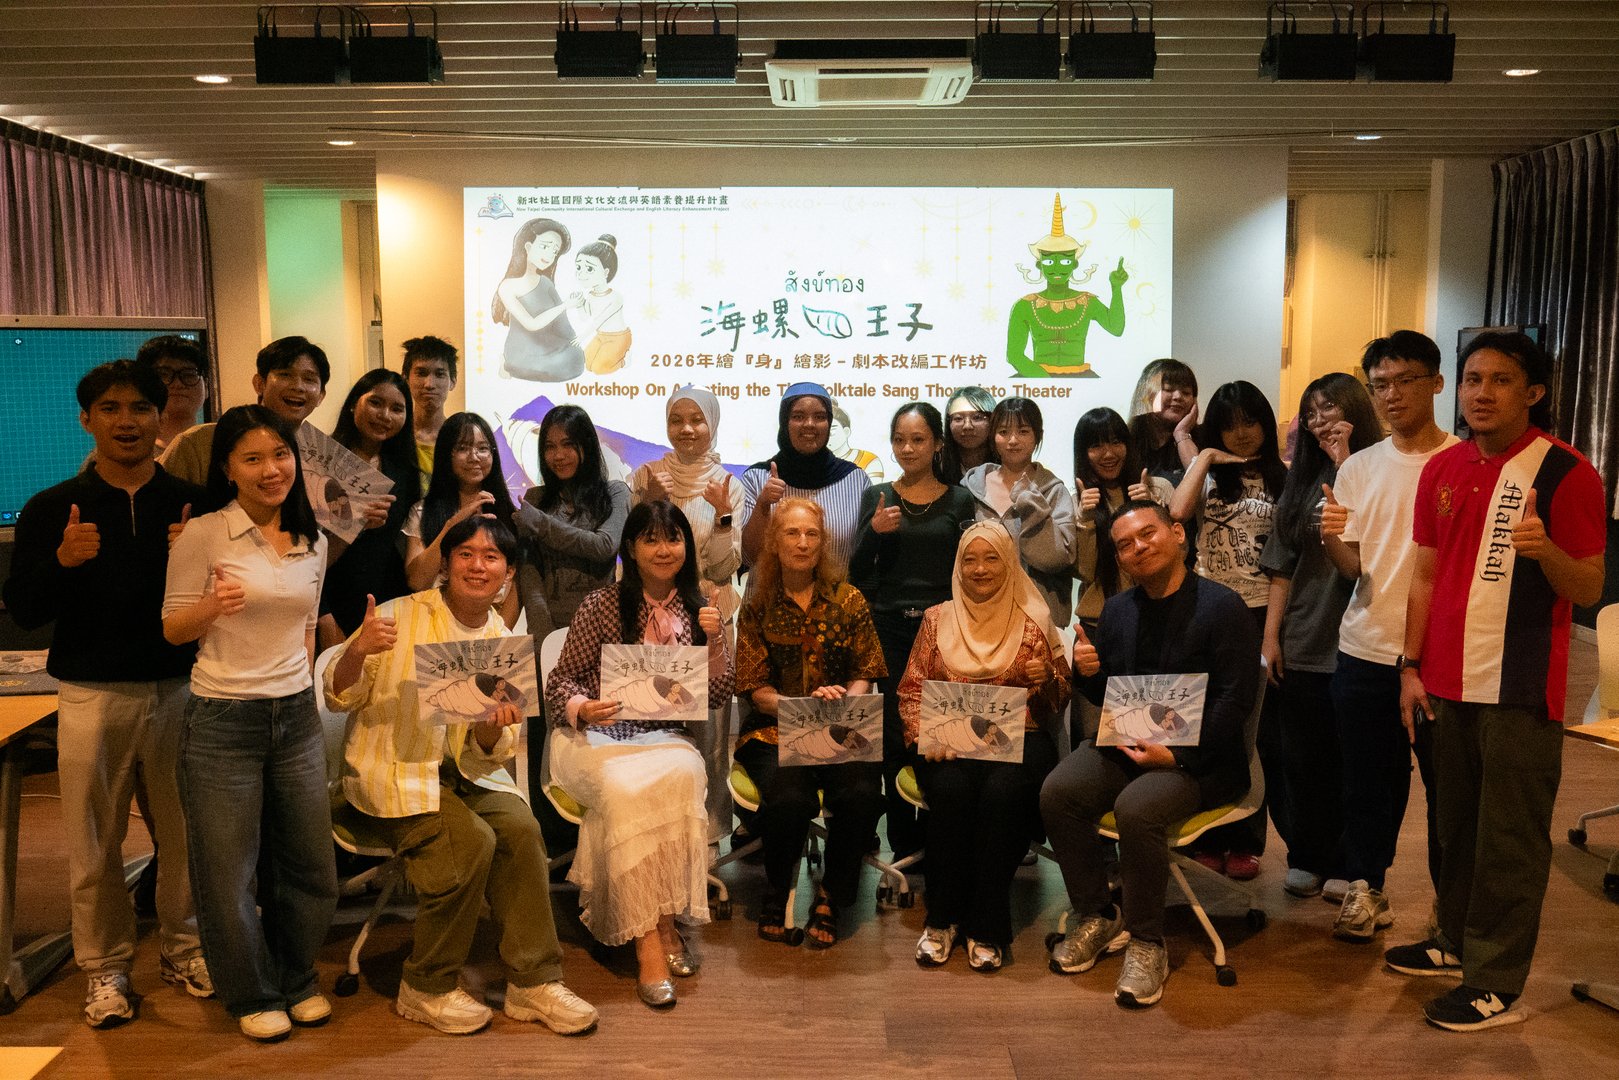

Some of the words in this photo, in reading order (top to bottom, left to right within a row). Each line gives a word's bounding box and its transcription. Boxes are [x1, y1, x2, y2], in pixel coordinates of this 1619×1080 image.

[700, 298, 799, 352] 海螺
[866, 302, 933, 342] 王子
[566, 381, 640, 399] Workshop
[645, 383, 666, 396] On
[746, 382, 771, 396] the
[818, 382, 876, 397] olktale
[882, 384, 919, 400] Sang
[1012, 383, 1072, 398] Theater
[493, 652, 518, 668] 王子
[670, 660, 693, 674] 王子
[1168, 687, 1190, 701] 王子
[846, 708, 868, 722] 王子
[988, 701, 1011, 716] 王子
